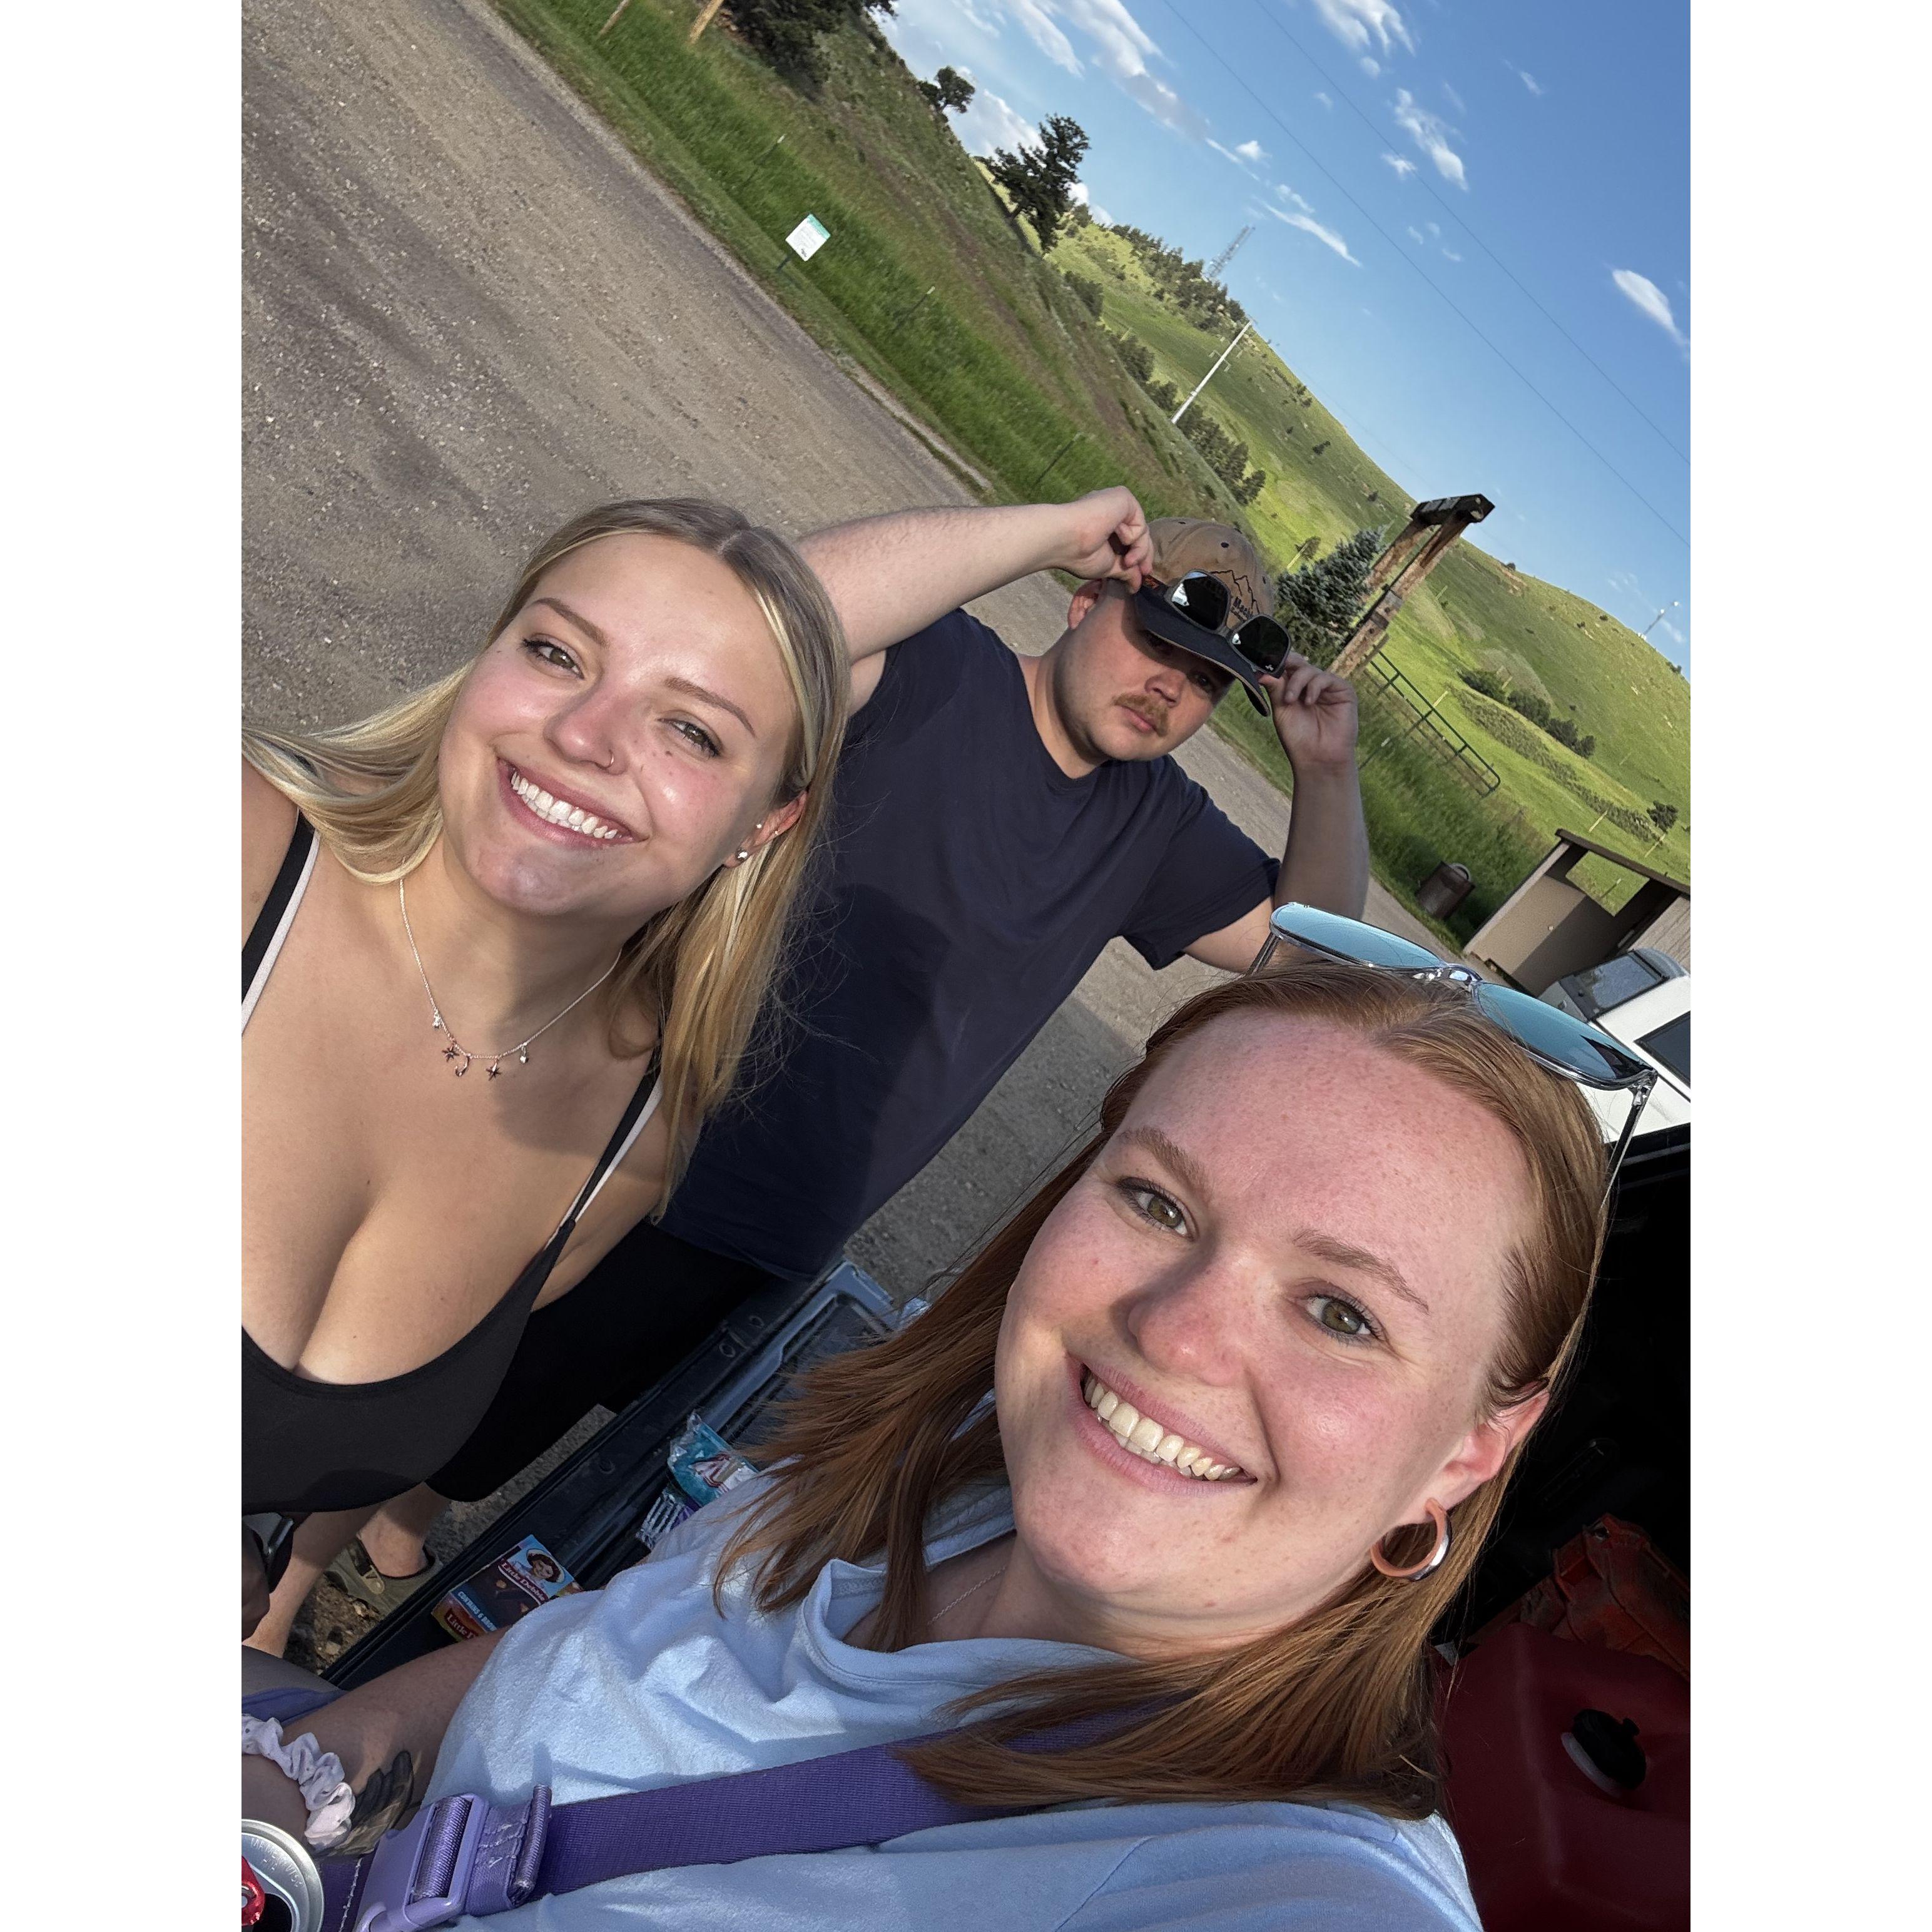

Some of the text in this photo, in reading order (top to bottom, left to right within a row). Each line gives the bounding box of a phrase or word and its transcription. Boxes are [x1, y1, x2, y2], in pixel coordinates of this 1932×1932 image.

[502, 1562, 546, 1601] Little Debbie
[457, 1591, 480, 1615] CONTAINS
[447, 1614, 467, 1635] Little
